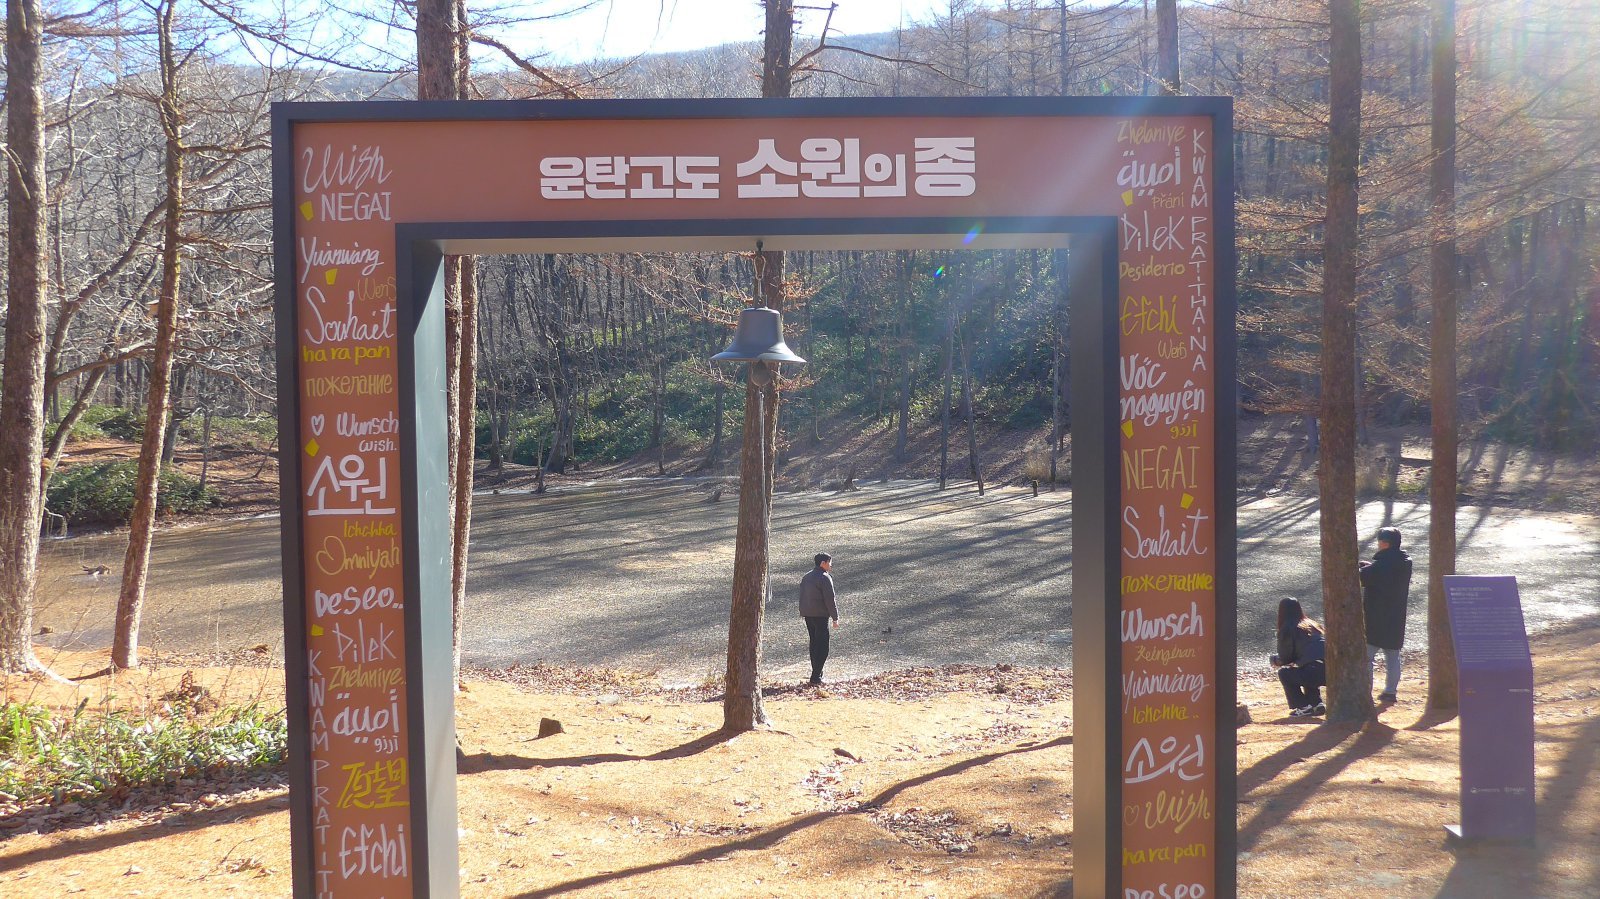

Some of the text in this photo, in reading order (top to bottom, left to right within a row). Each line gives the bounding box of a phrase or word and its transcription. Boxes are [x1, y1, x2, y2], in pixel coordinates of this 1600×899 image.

[539, 156, 720, 199] 운탄고도
[321, 191, 392, 222] NEGAI
[1120, 255, 1186, 281] Desiderio
[305, 286, 398, 345] Souhait
[306, 374, 393, 397] пожелание
[337, 411, 399, 437] Wunsch
[307, 454, 396, 516] 소원
[1123, 445, 1200, 490] NEGAI
[1123, 505, 1208, 559] Souhait
[1121, 573, 1214, 595] пожелание
[1121, 601, 1204, 642] Wunsch
